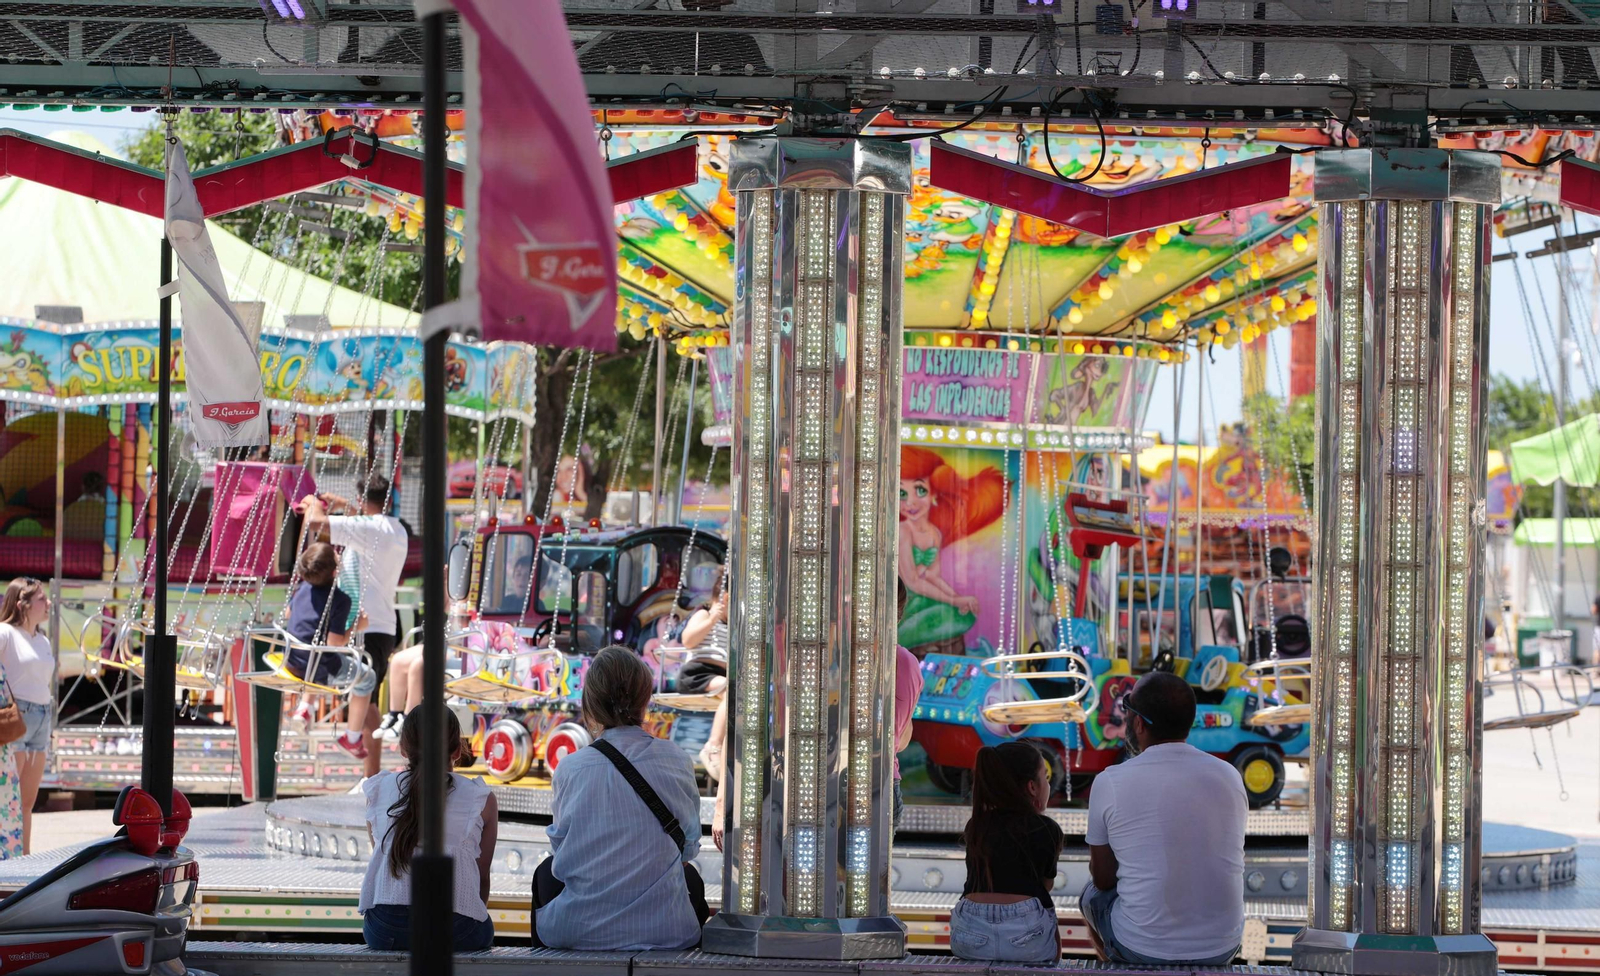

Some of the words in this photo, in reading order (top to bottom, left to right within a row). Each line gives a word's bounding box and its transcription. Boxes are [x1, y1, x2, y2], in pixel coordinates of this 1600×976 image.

[906, 347, 923, 374] NO
[925, 348, 1003, 379] RESPONDEMOS
[909, 381, 932, 414] LAS
[935, 381, 1011, 418] IMPRUDENCIAS
[8, 951, 50, 961] vodafone
